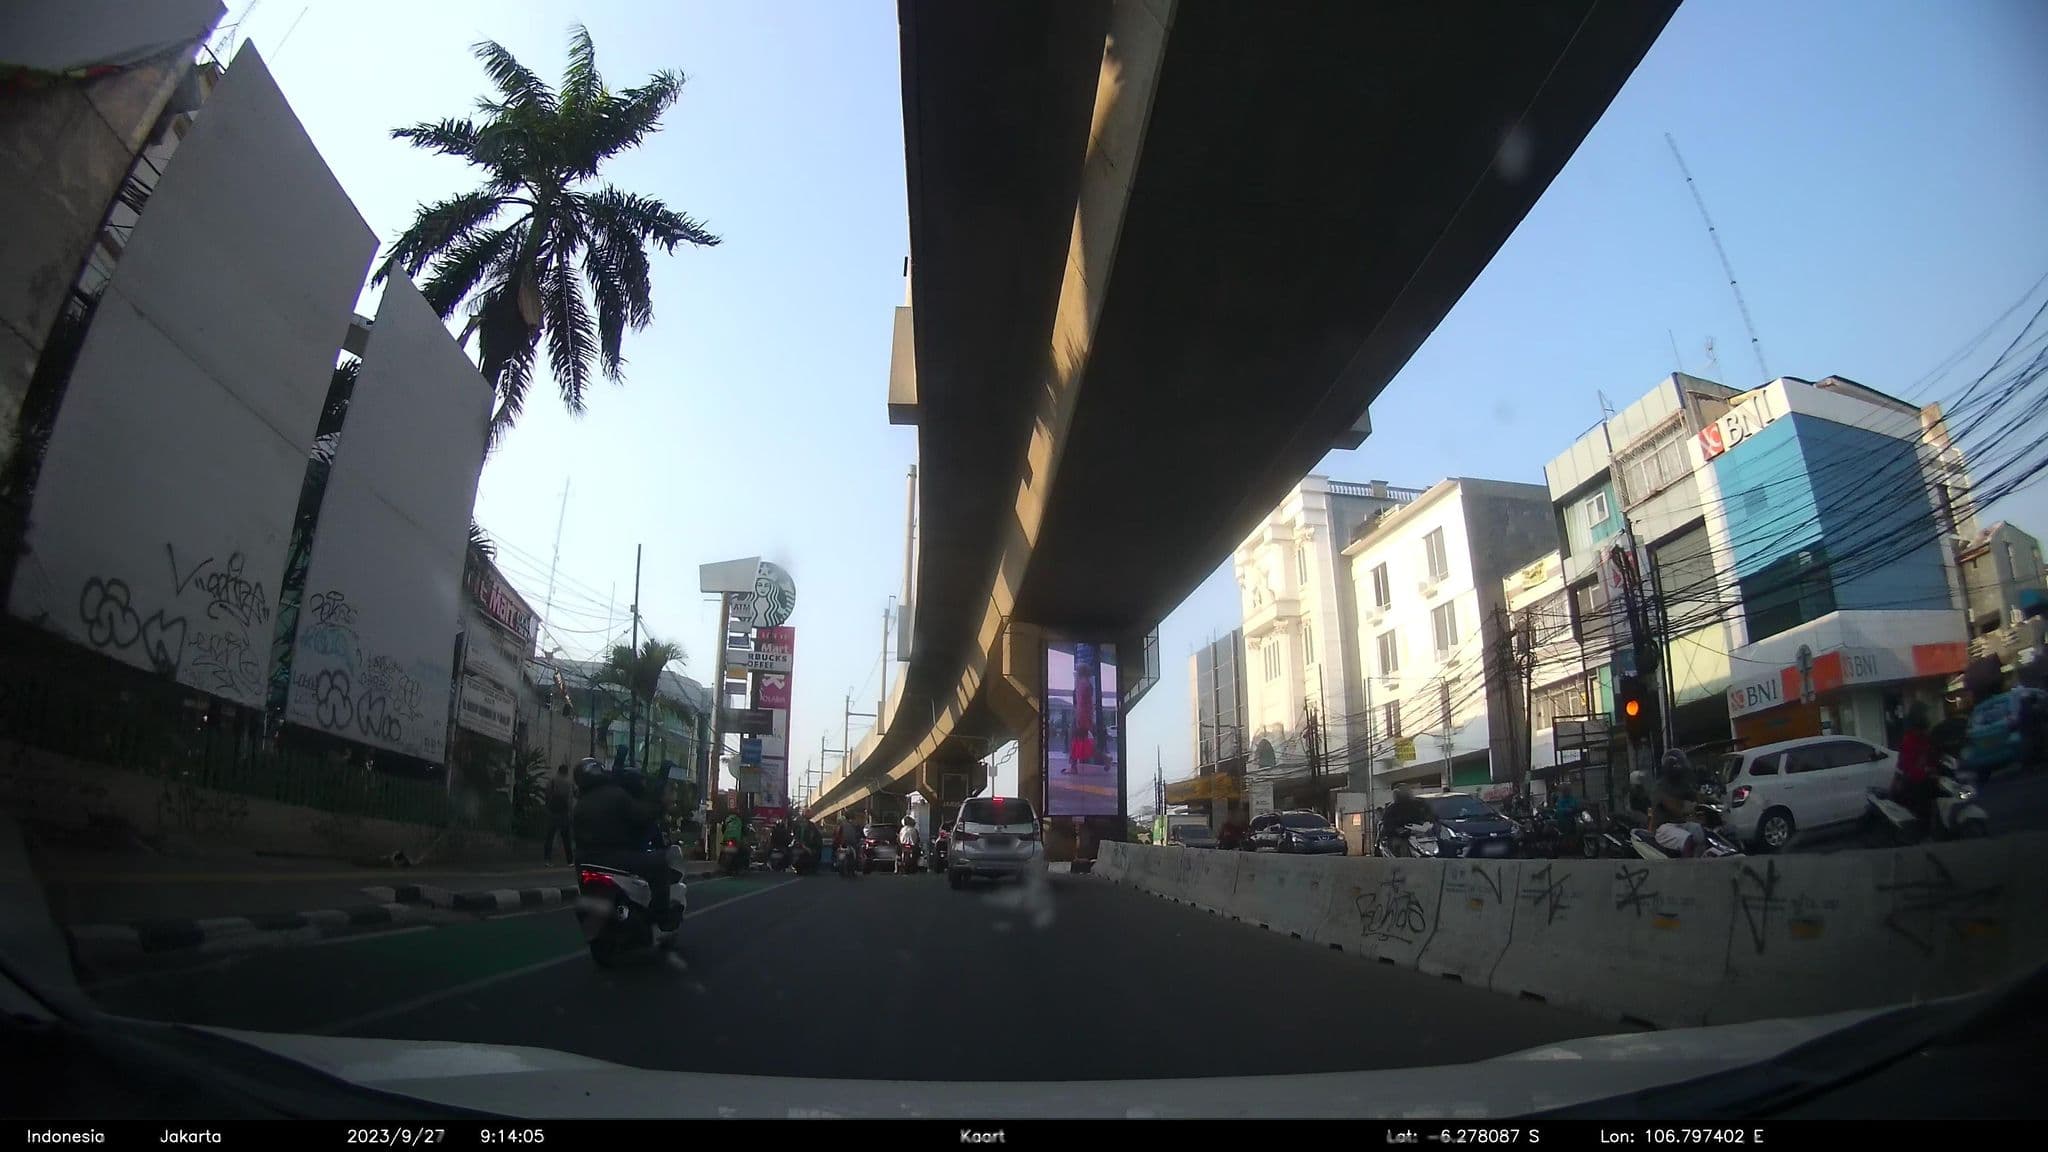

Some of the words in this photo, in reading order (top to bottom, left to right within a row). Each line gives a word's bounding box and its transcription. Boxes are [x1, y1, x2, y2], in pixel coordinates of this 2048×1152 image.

[1726, 389, 1775, 449] BNI
[733, 603, 751, 611] ATM
[747, 653, 787, 663] RBUCKS
[747, 660, 775, 669] OFFEE
[1854, 654, 1878, 675] BNI
[1746, 679, 1777, 707] BNI
